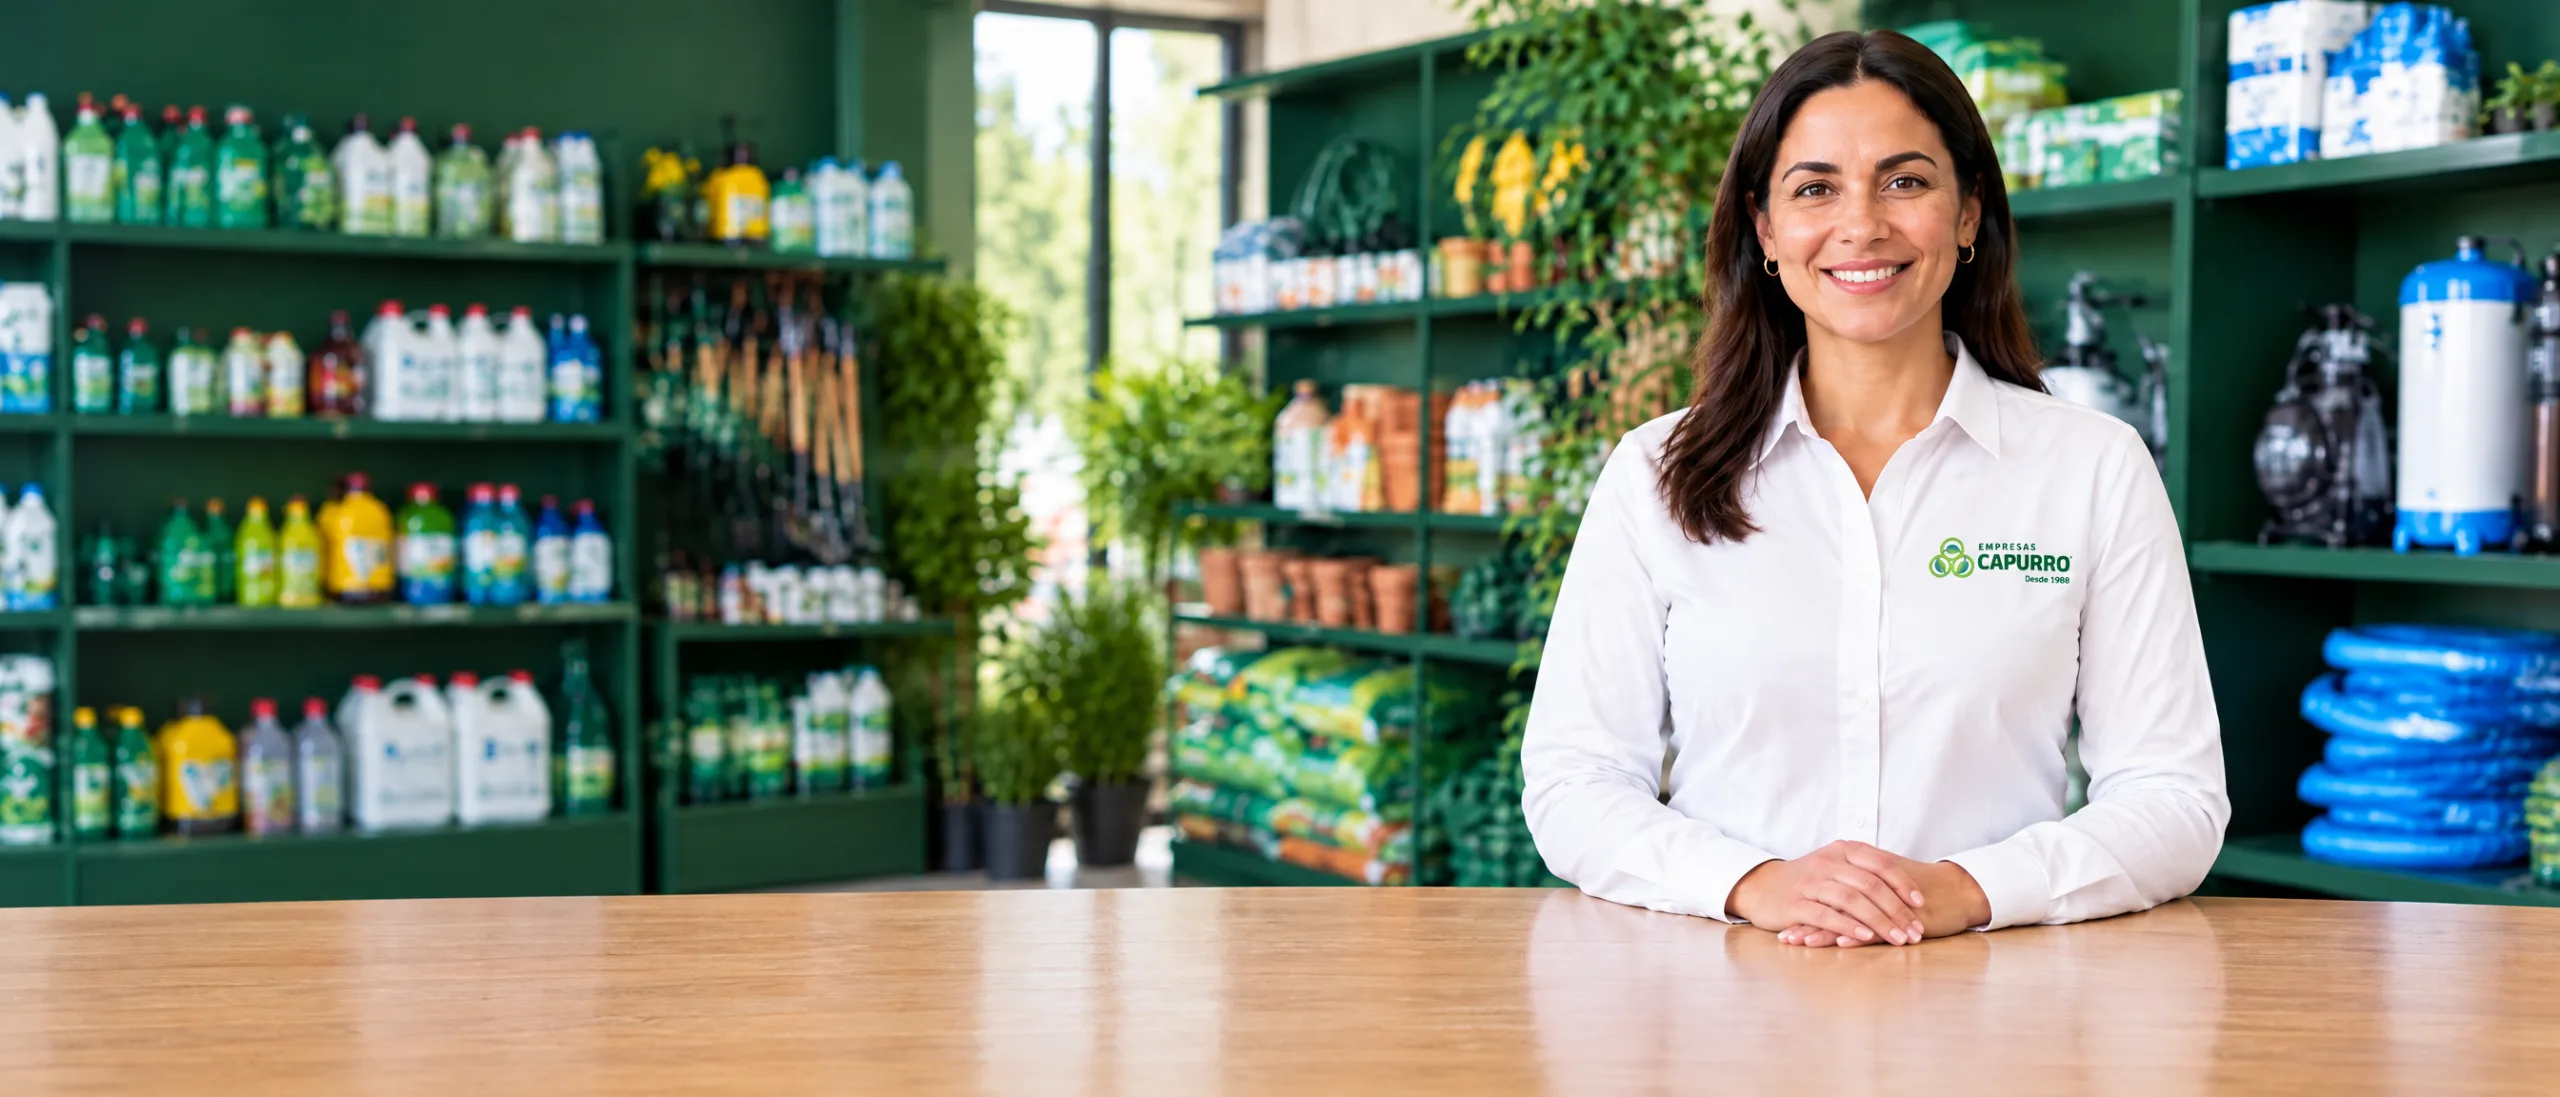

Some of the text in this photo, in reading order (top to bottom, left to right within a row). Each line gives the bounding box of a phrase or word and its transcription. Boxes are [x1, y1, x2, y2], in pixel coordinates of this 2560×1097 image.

[1977, 554, 2070, 572] CAPURRO
[2025, 575, 2070, 584] Desde 1988
